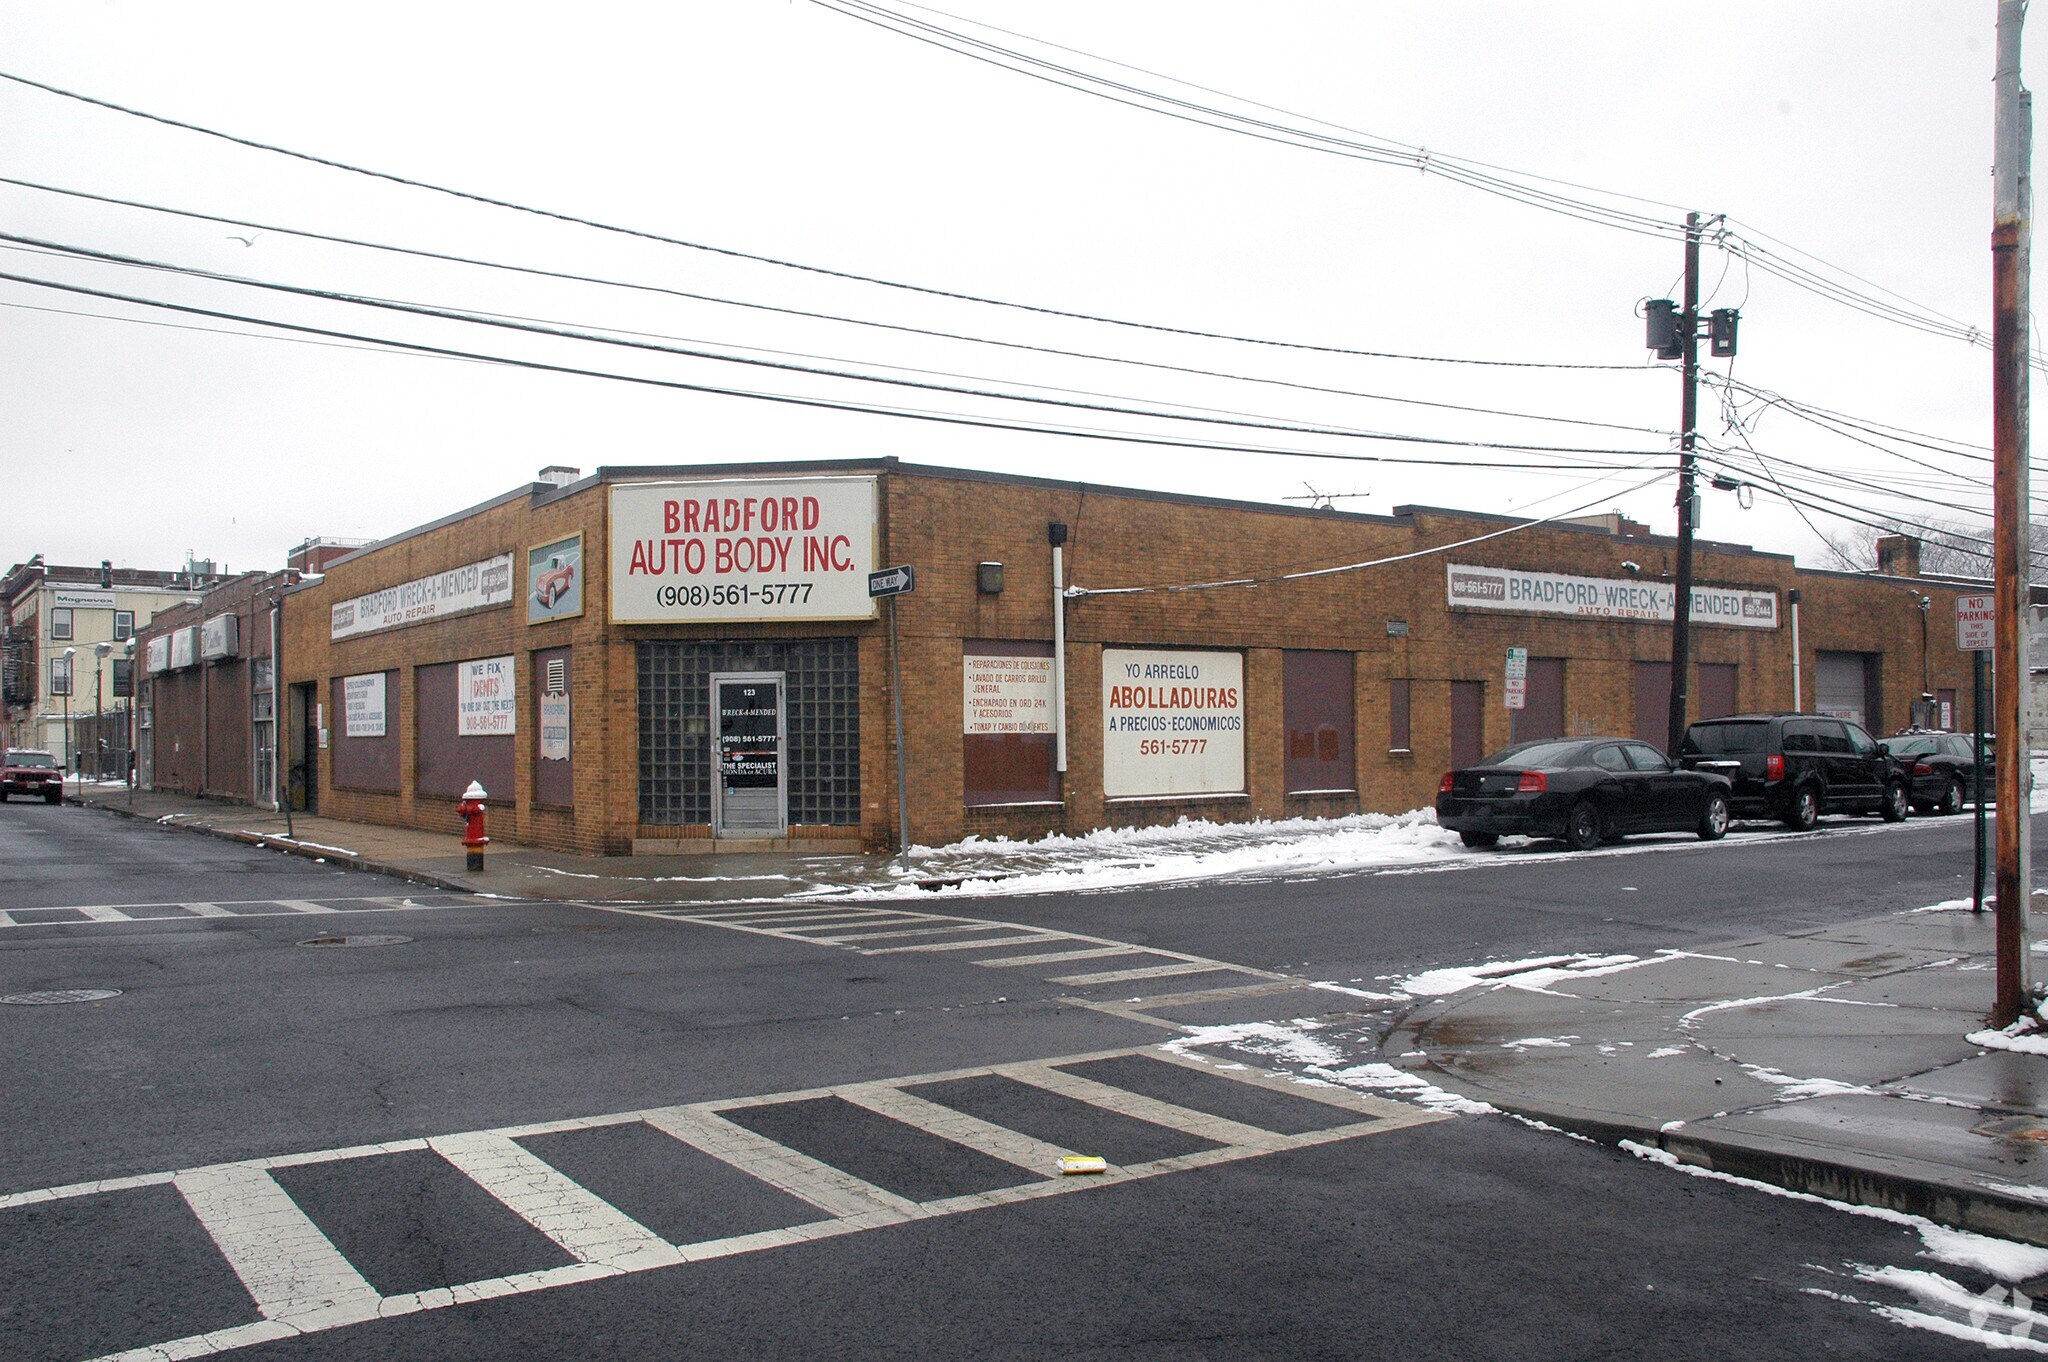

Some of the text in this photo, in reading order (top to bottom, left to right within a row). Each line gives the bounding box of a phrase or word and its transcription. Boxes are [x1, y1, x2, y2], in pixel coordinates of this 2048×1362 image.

[664, 496, 820, 534] BRADFORD
[629, 534, 855, 576] AUTO BODY INC.
[872, 575, 898, 590] ONE WAY
[1453, 581, 1503, 596] 908-561-5777
[360, 586, 398, 619] BRADFORD
[400, 566, 479, 609] WRECK-A-MENDED
[1509, 578, 1598, 606] BRADFORD
[1968, 598, 1984, 609] NO
[383, 603, 435, 625] AUTO REPAIR
[1577, 606, 1660, 619] AUTO REPAIR
[1957, 610, 1995, 621] PARKING
[1965, 631, 1978, 639] SIDE
[472, 662, 501, 675] WE FIX
[972, 661, 1012, 669] REPARACIONES
[1013, 661, 1020, 670] DE
[1125, 663, 1200, 680] YO ARREGLO
[972, 674, 1047, 684] LAVADO DE CARROS BRILLO
[473, 678, 500, 698] DENTS
[973, 685, 1001, 693] JENERAL
[972, 698, 1047, 708] ENCHAPADO EN ORO 24K
[1109, 685, 1238, 709] ABOLLADURAS
[722, 708, 777, 716] WRECK-A-MENDED
[973, 709, 1013, 718] Y ACESORIOS
[993, 723, 997, 731] Y
[1109, 716, 1117, 732] A
[722, 735, 776, 744] (908) 561-5777
[1140, 739, 1208, 755] 561-5777
